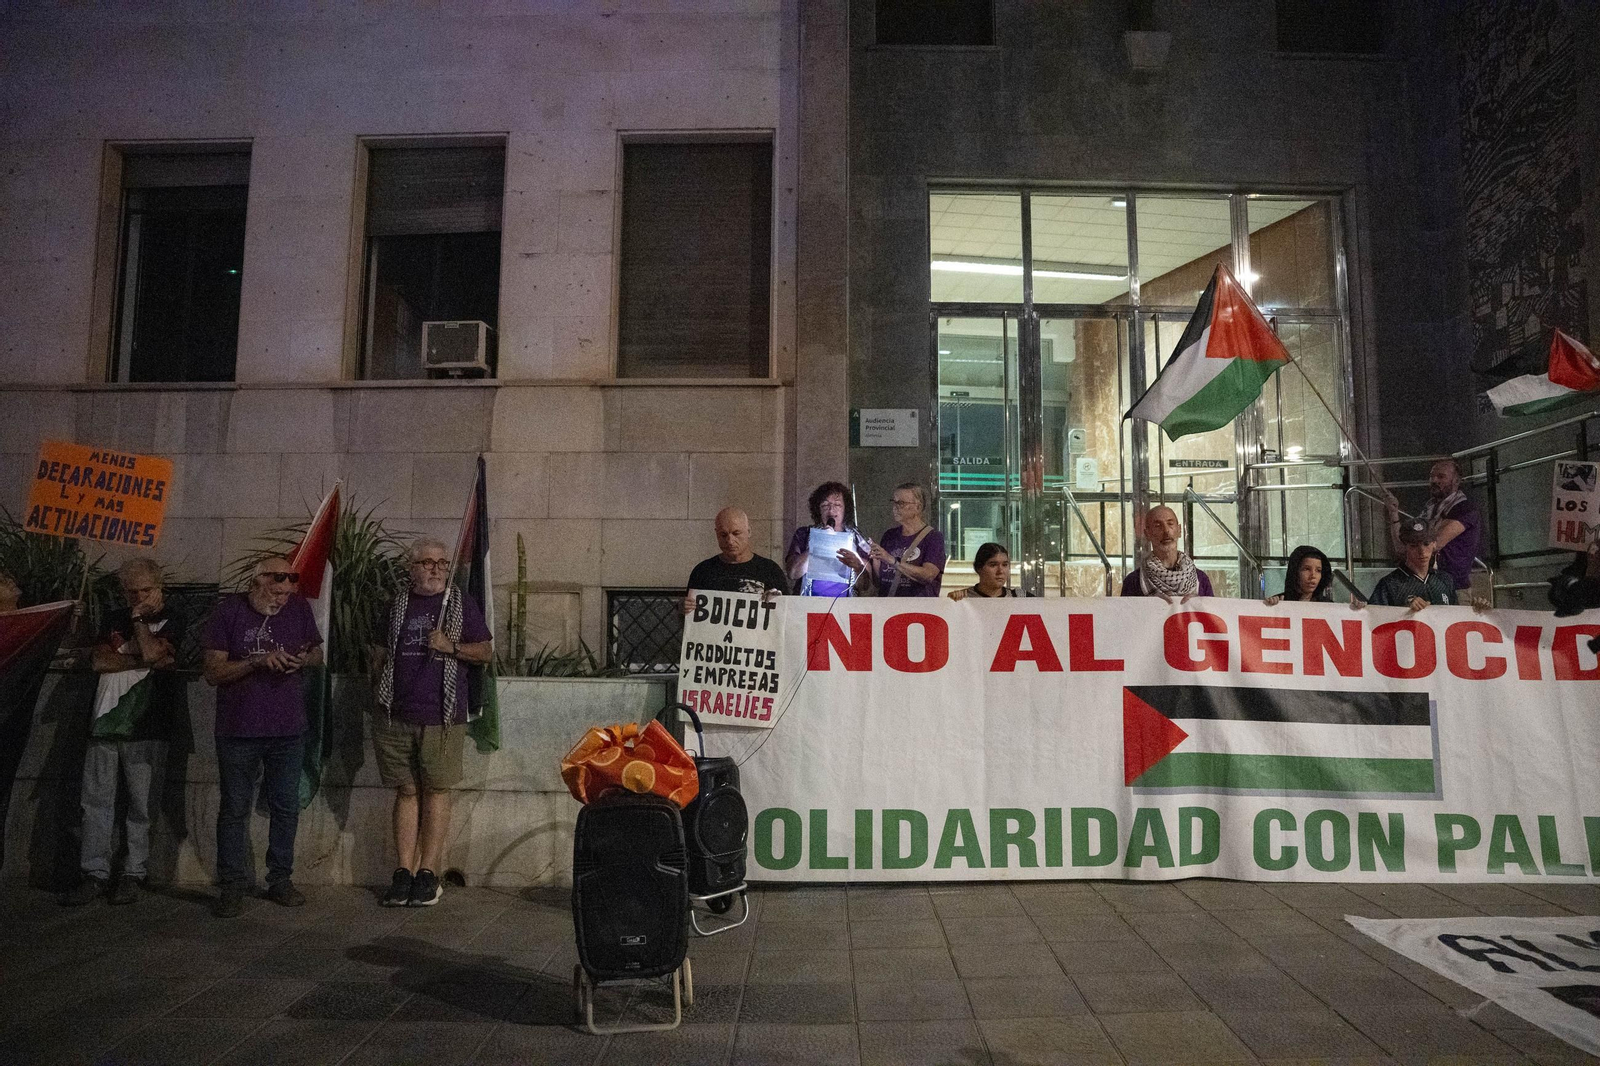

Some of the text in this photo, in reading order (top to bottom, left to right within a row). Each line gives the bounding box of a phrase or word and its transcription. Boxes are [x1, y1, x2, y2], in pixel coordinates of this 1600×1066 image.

[89, 452, 136, 470] MENOS
[953, 457, 990, 465] SALIDA
[1175, 460, 1222, 468] ENTRADA
[37, 460, 166, 502] DECARACIONES
[1556, 498, 1588, 512] LOS
[26, 504, 157, 546] ACTUACIONES
[693, 594, 776, 630] BOICOT
[723, 630, 733, 643] A
[807, 611, 1600, 681] NO AL GENOCID
[685, 641, 776, 671] PRODUCTOS
[693, 666, 780, 693] EMPRESAS
[682, 690, 774, 722] ISRAELÍES
[754, 807, 1221, 871] OLIDARIDAD
[1253, 808, 1406, 873] CON
